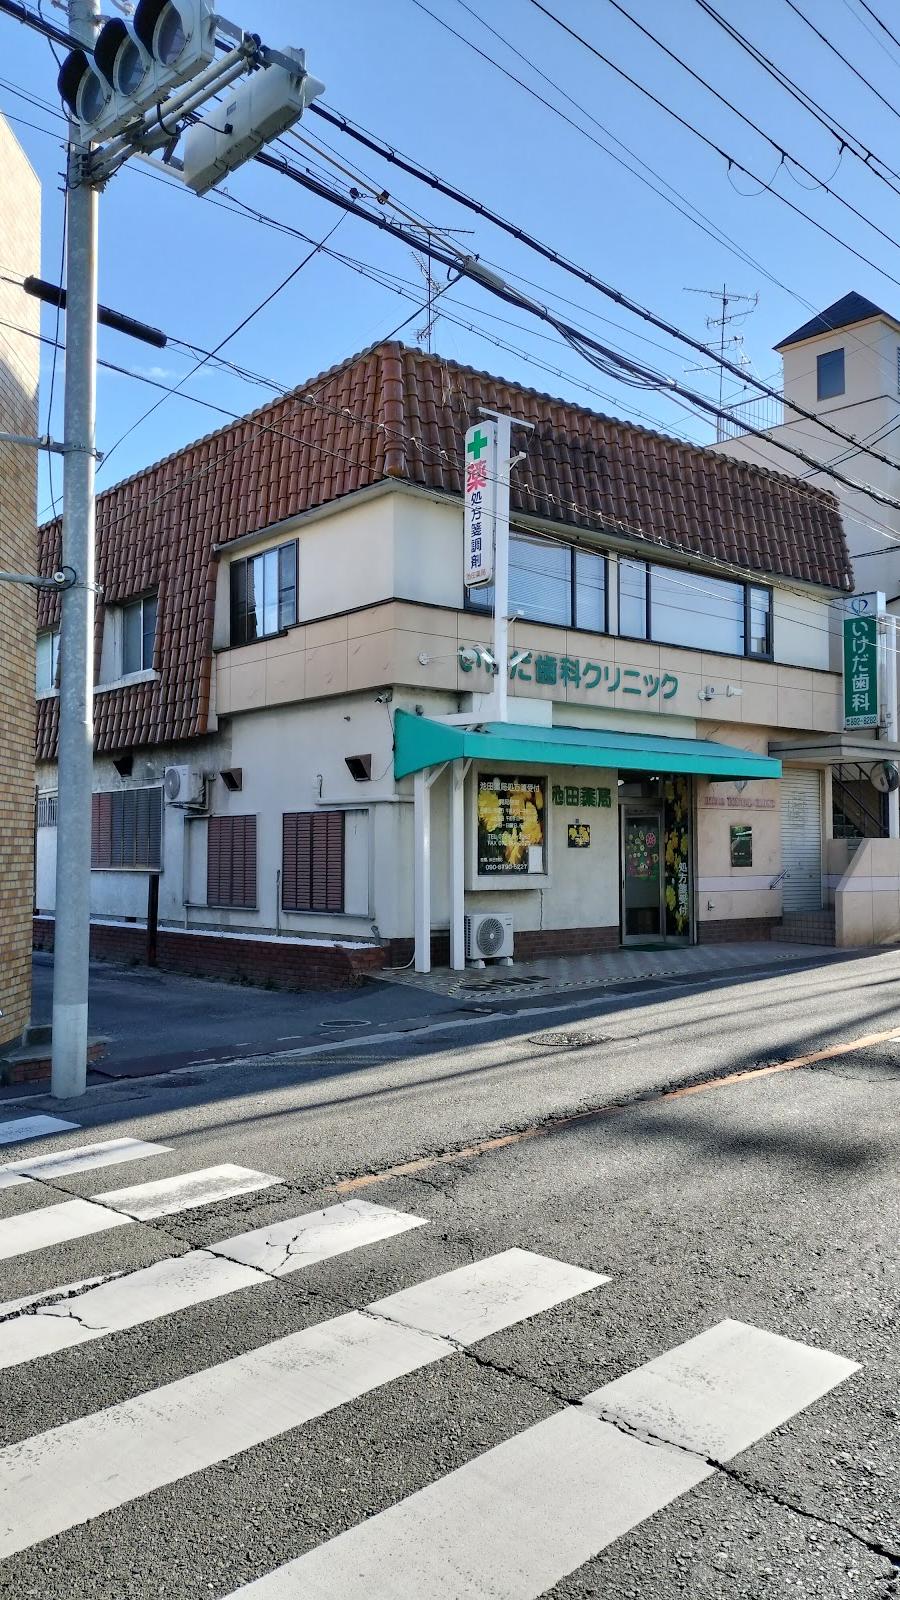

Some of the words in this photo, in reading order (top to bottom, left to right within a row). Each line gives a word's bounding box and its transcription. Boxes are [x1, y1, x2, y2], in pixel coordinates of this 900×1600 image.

[466, 460, 488, 493] 薬
[470, 491, 483, 569] 処方箋調剤
[851, 621, 871, 713] いけだ歯科
[551, 785, 612, 808] 池田薬局
